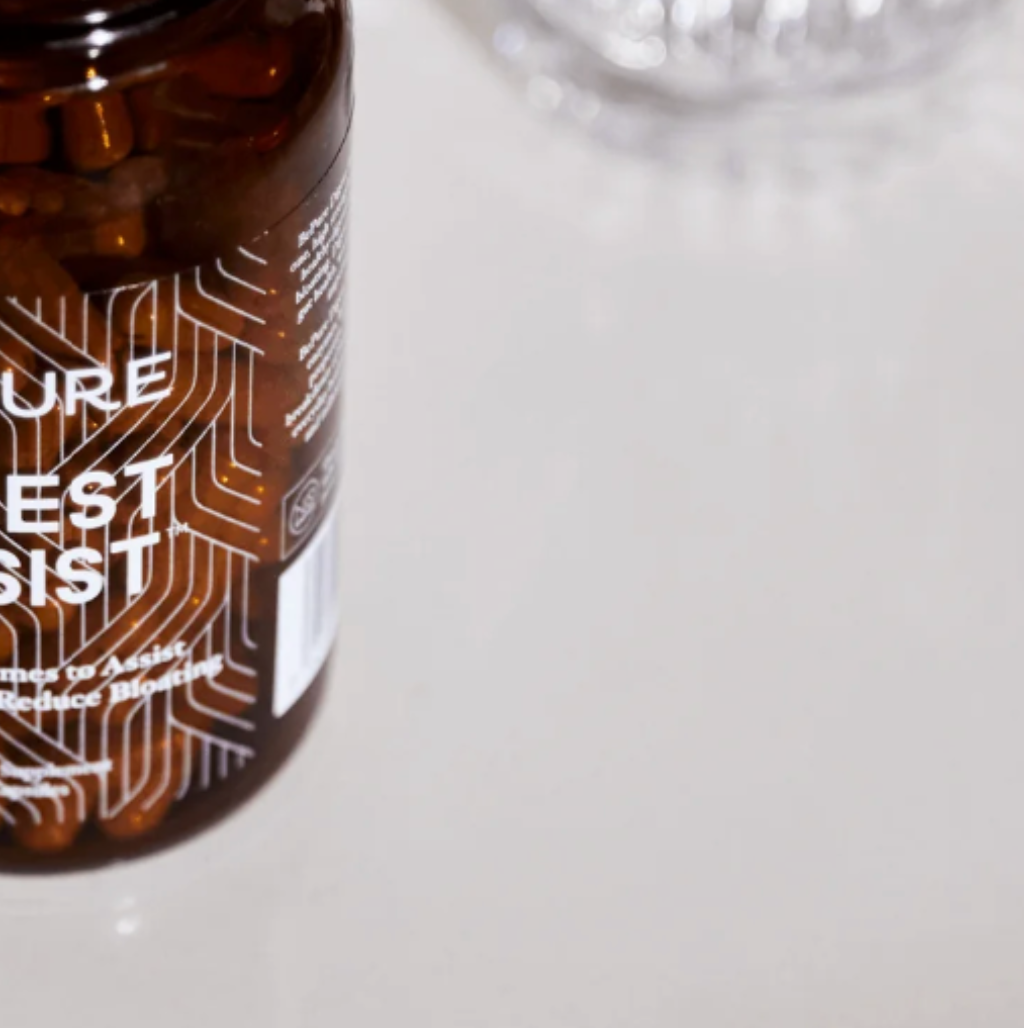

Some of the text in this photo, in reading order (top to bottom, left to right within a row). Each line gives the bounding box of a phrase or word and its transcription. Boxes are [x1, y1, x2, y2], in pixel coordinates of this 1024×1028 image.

[66, 664, 96, 681] to
[100, 640, 187, 678] Assist
[109, 653, 225, 705] Bloating
